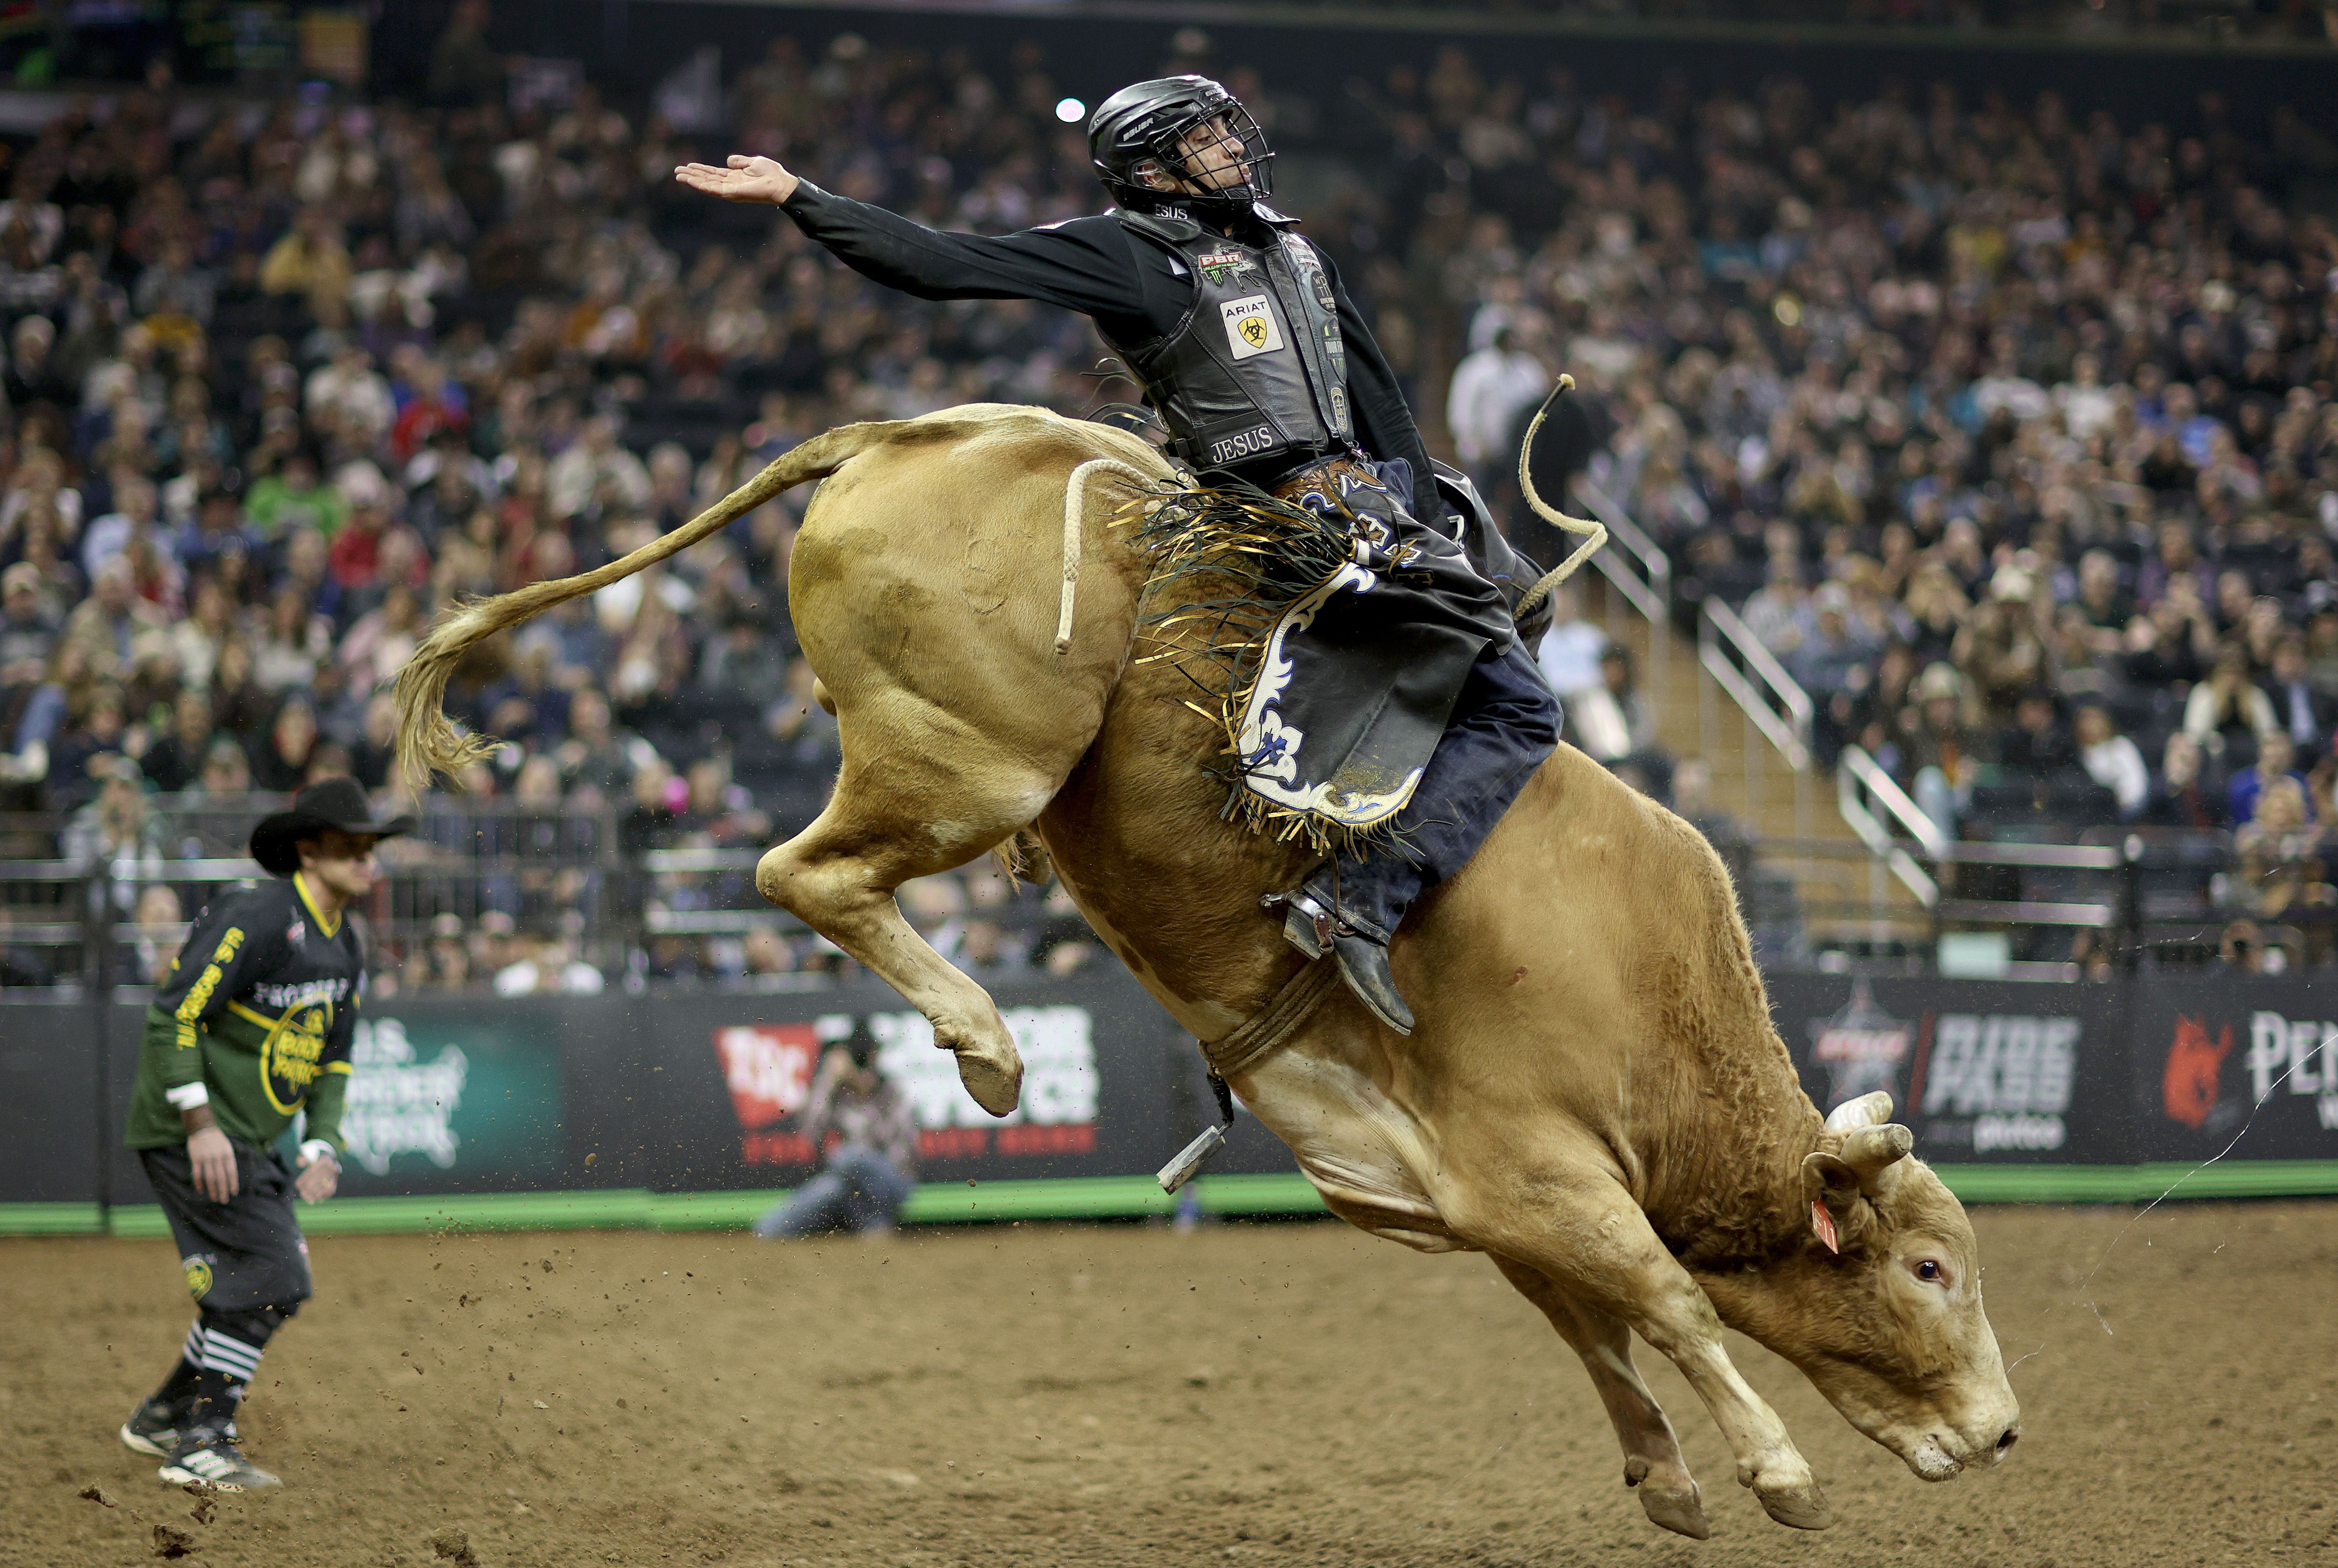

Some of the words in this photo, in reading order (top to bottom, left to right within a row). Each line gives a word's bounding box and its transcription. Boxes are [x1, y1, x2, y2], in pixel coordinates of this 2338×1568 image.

[1155, 203, 1188, 220] ESUS
[1201, 254, 1239, 266] PBR
[1226, 301, 1266, 318] ARIAT
[1210, 426, 1273, 463] JESUS
